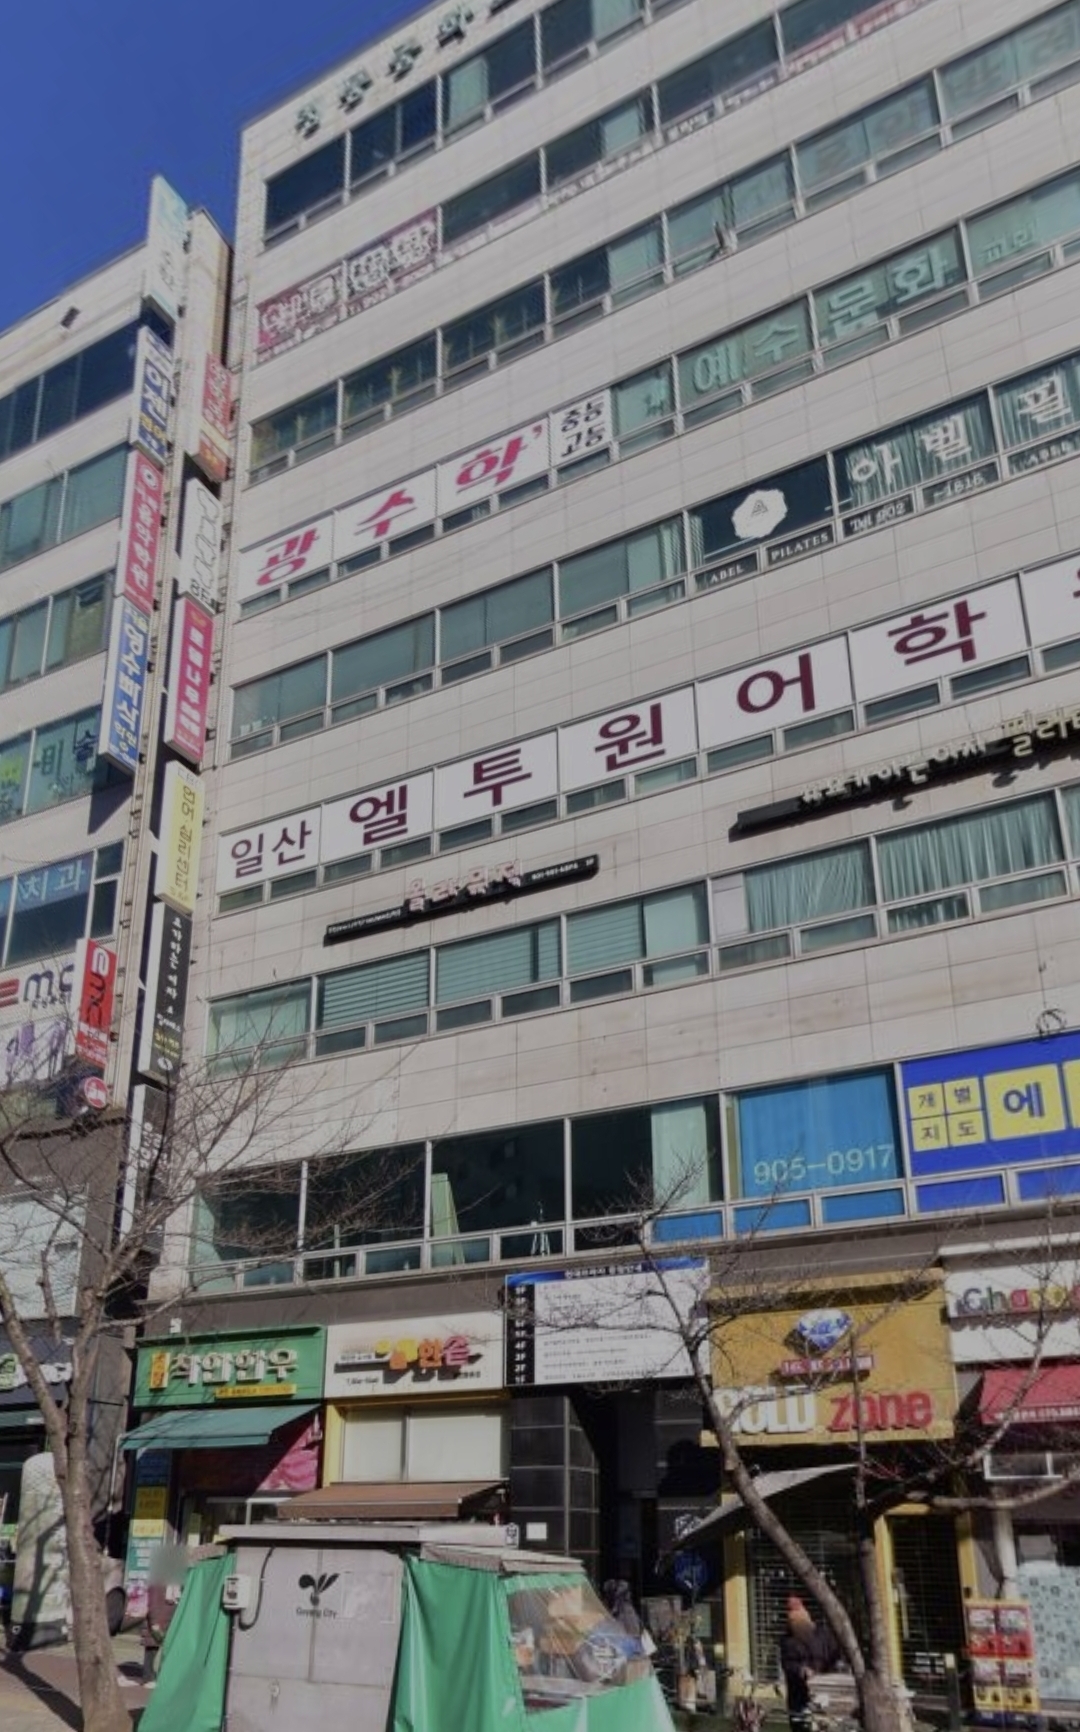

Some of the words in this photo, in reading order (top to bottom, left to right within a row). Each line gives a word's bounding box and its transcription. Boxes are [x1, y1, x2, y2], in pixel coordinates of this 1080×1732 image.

[692, 243, 957, 392] 예수문화
[560, 400, 604, 433] 중등
[560, 422, 606, 458] 고등
[849, 413, 972, 487] 아벨
[709, 563, 746, 584] ABEL
[770, 531, 830, 563] PILATES
[113, 719, 136, 749] 학원
[229, 819, 312, 880] 일산
[18, 860, 86, 901] 치과
[918, 1086, 972, 1109] 개별
[1002, 1081, 1046, 1119] 에
[921, 1120, 976, 1142] 지도
[753, 1144, 895, 1186] 905-0917
[171, 1349, 298, 1387] 착한한우
[826, 1390, 933, 1432] zone
